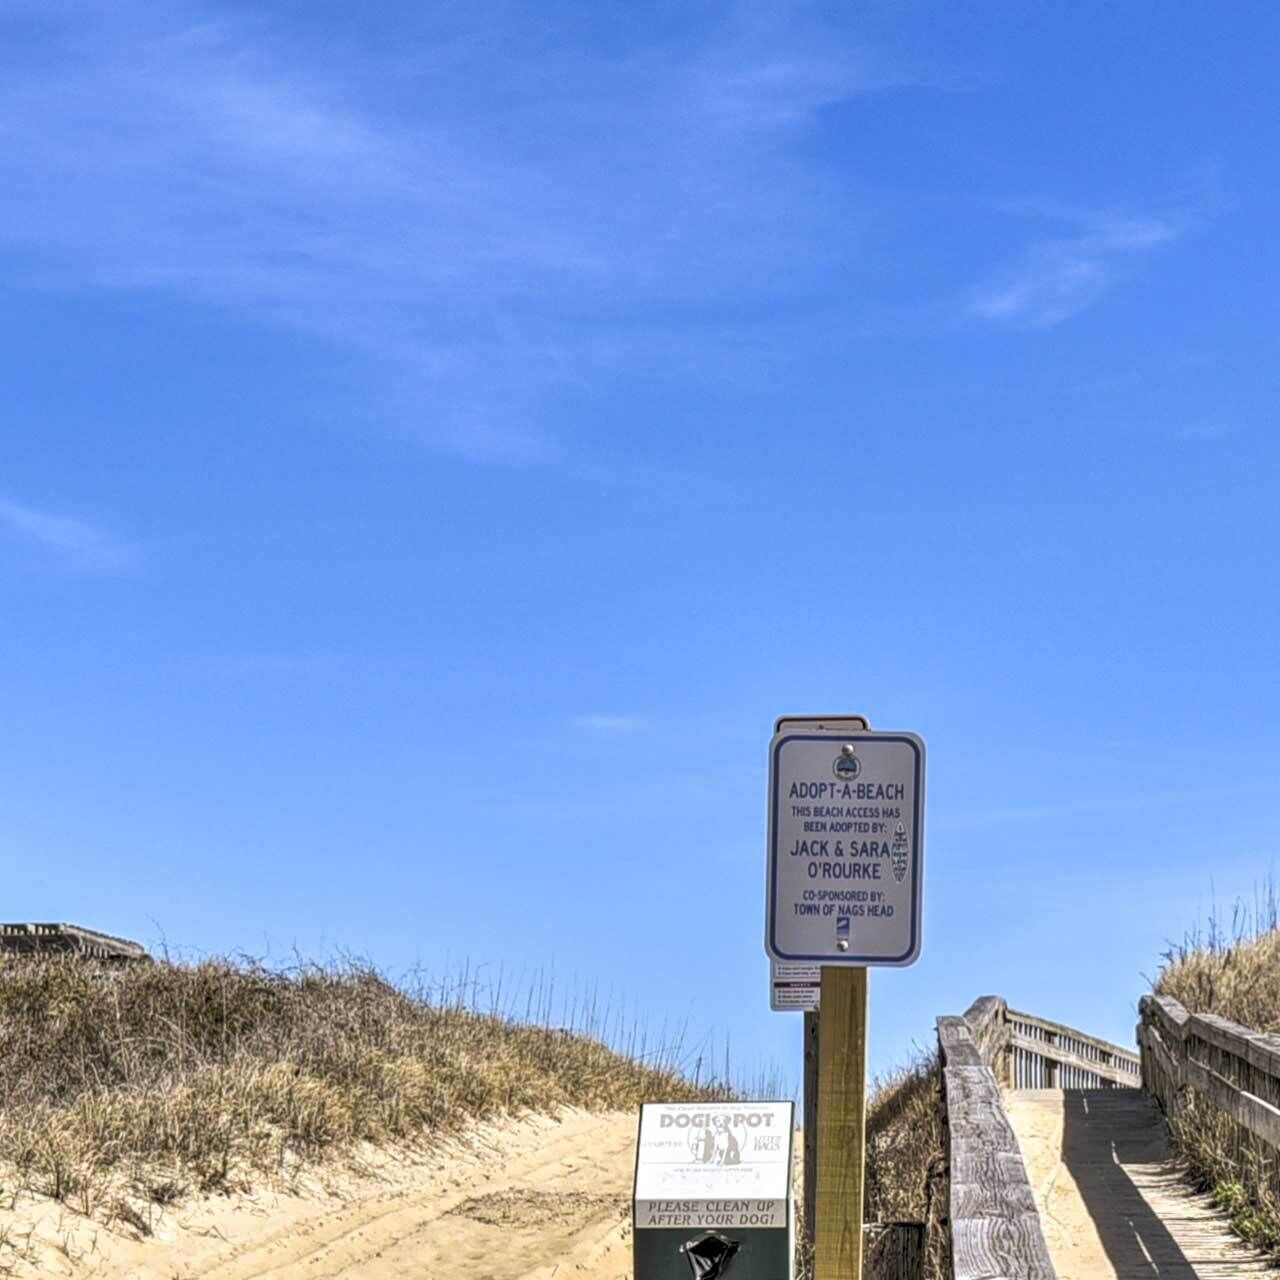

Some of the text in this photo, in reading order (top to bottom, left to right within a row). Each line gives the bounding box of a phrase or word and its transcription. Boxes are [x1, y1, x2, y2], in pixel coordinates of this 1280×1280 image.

[789, 781, 905, 801] ADOPT-A-BEACH
[791, 806, 901, 819] THIS BEACH ACCESS HAS
[803, 821, 827, 832] BEEN
[829, 821, 870, 833] ADOPTED
[790, 840, 891, 858] JACK & SARA
[807, 861, 882, 880] O'ROURKE
[802, 889, 869, 901] CO-SPONSORED
[793, 903, 895, 917] TOWN OF NAGS HEAD
[647, 1200, 775, 1213] PLEASE CLEAN UP
[647, 1213, 775, 1226] AFTER YOUR DOG!
